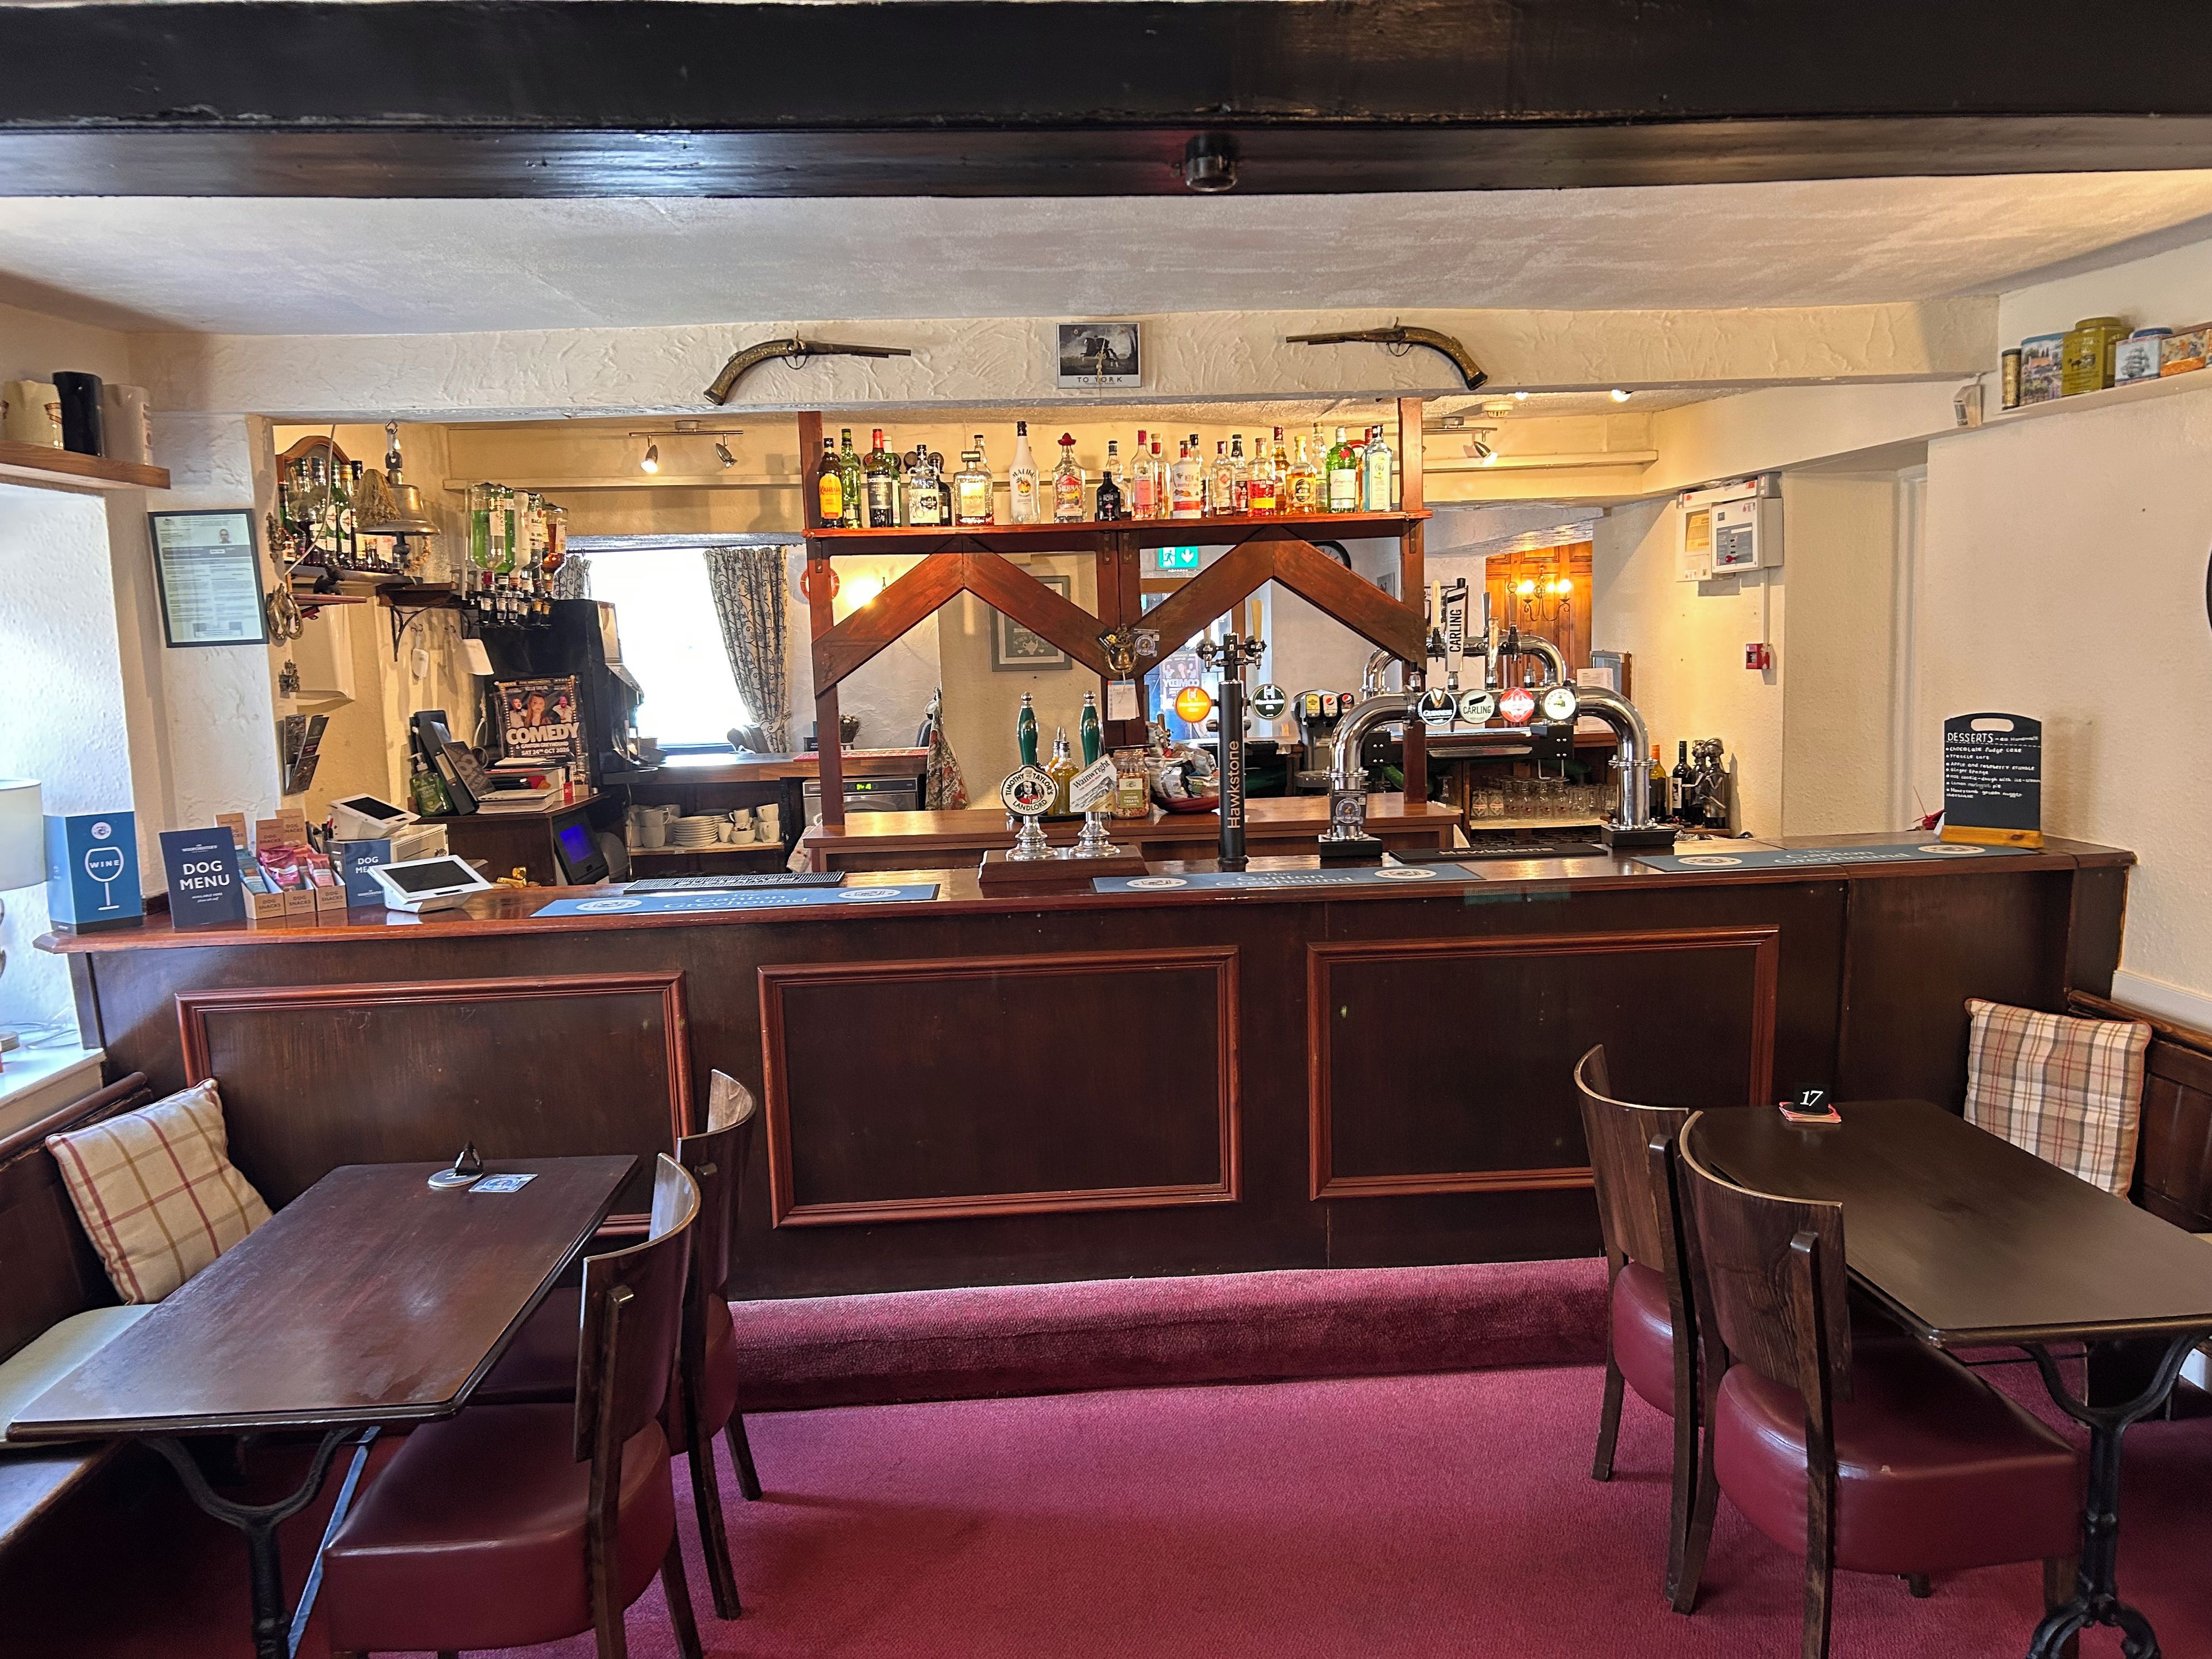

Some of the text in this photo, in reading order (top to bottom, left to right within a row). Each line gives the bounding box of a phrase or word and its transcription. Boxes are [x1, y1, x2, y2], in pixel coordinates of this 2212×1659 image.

[1449, 608, 1462, 653] CARLING
[1463, 705, 1492, 714] CARLING
[506, 722, 580, 745] COMEDY
[1948, 733, 1994, 743] DESSERTS
[1073, 760, 1111, 788] Wainwright
[1005, 773, 1053, 796] TIMOTHY TAYLOR'S
[1226, 740, 1241, 828] Hawkstone
[1012, 799, 1048, 811] LANDLORD
[89, 859, 120, 869] WINE
[358, 856, 378, 865] DOG
[1774, 853, 1911, 863] Greyhound
[183, 860, 223, 875] DOG
[179, 874, 230, 891] MENU
[1215, 877, 1354, 887] Greyhound
[664, 897, 808, 908] Greyhound
[1800, 1090, 1824, 1106] 17
